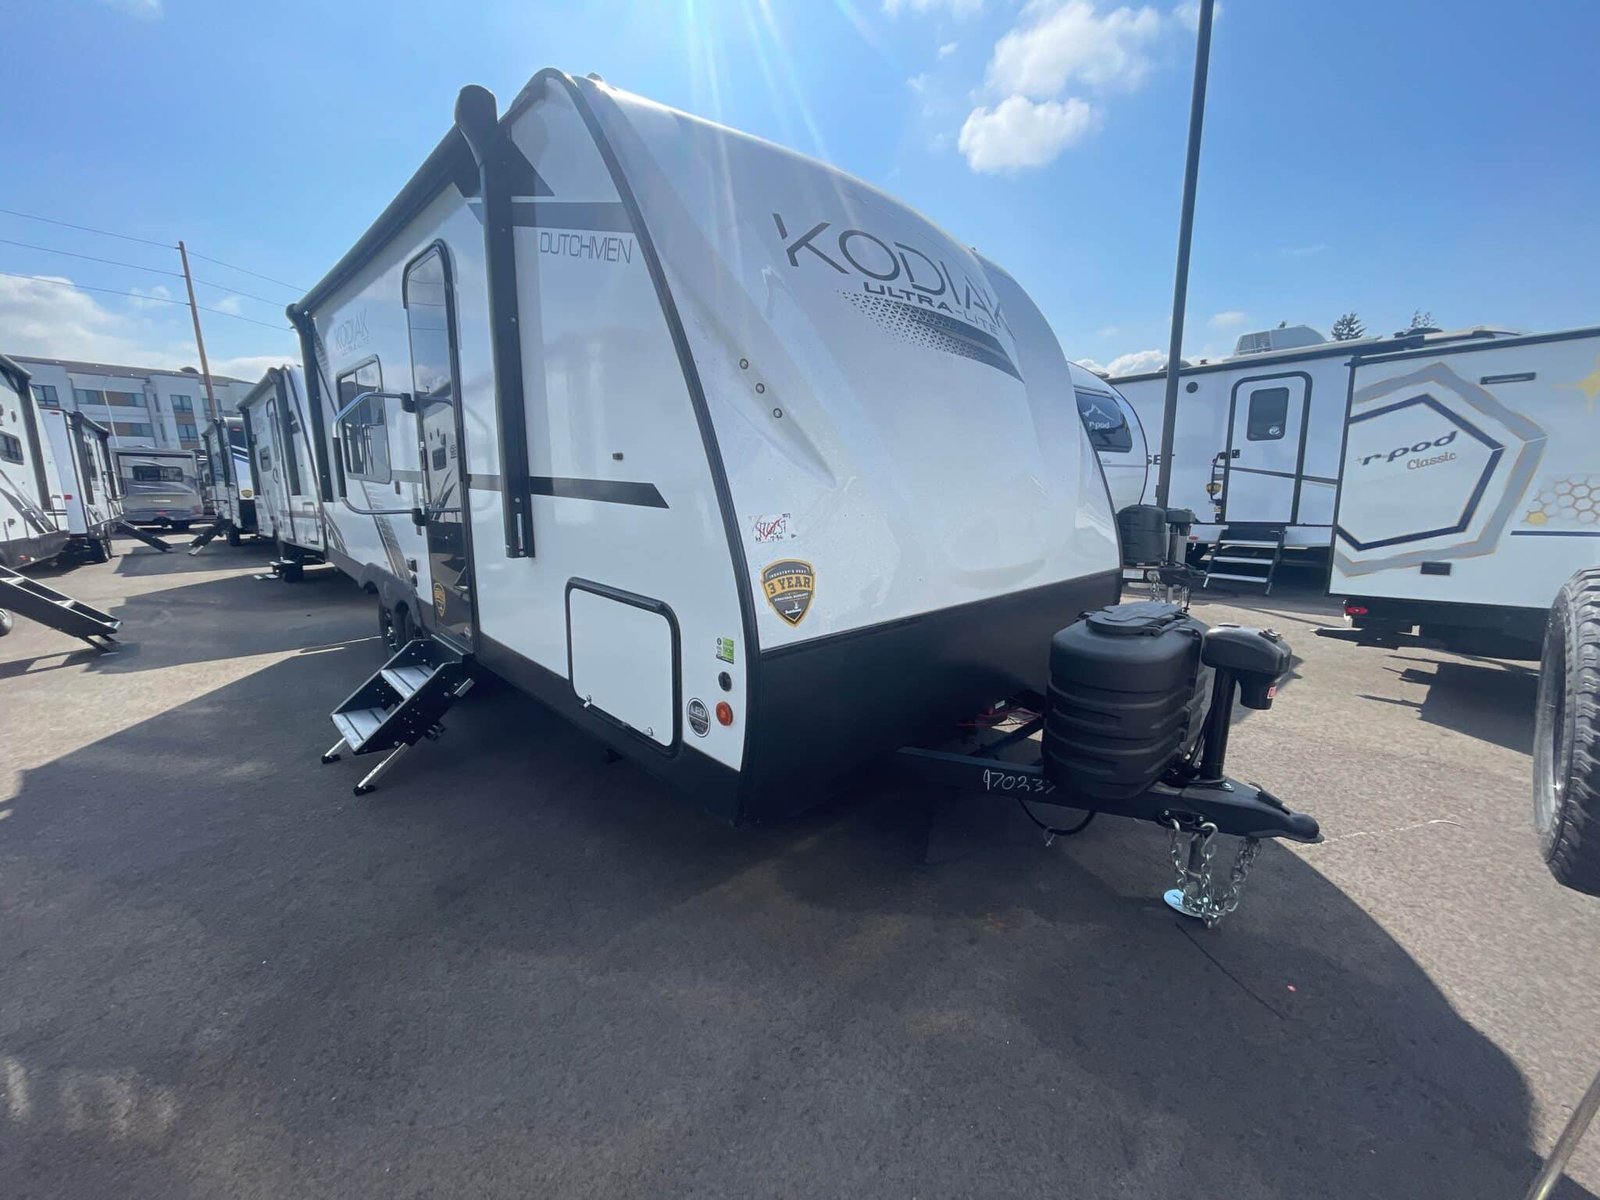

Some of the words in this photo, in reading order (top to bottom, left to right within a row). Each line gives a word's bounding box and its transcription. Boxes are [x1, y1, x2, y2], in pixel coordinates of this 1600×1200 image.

[540, 231, 632, 264] DUTCHMEN
[772, 213, 1016, 342] KODIAK
[863, 281, 999, 335] ULTRA-LITE
[1406, 452, 1457, 470] Classic
[767, 582, 777, 595] 3
[777, 575, 811, 591] YEAR
